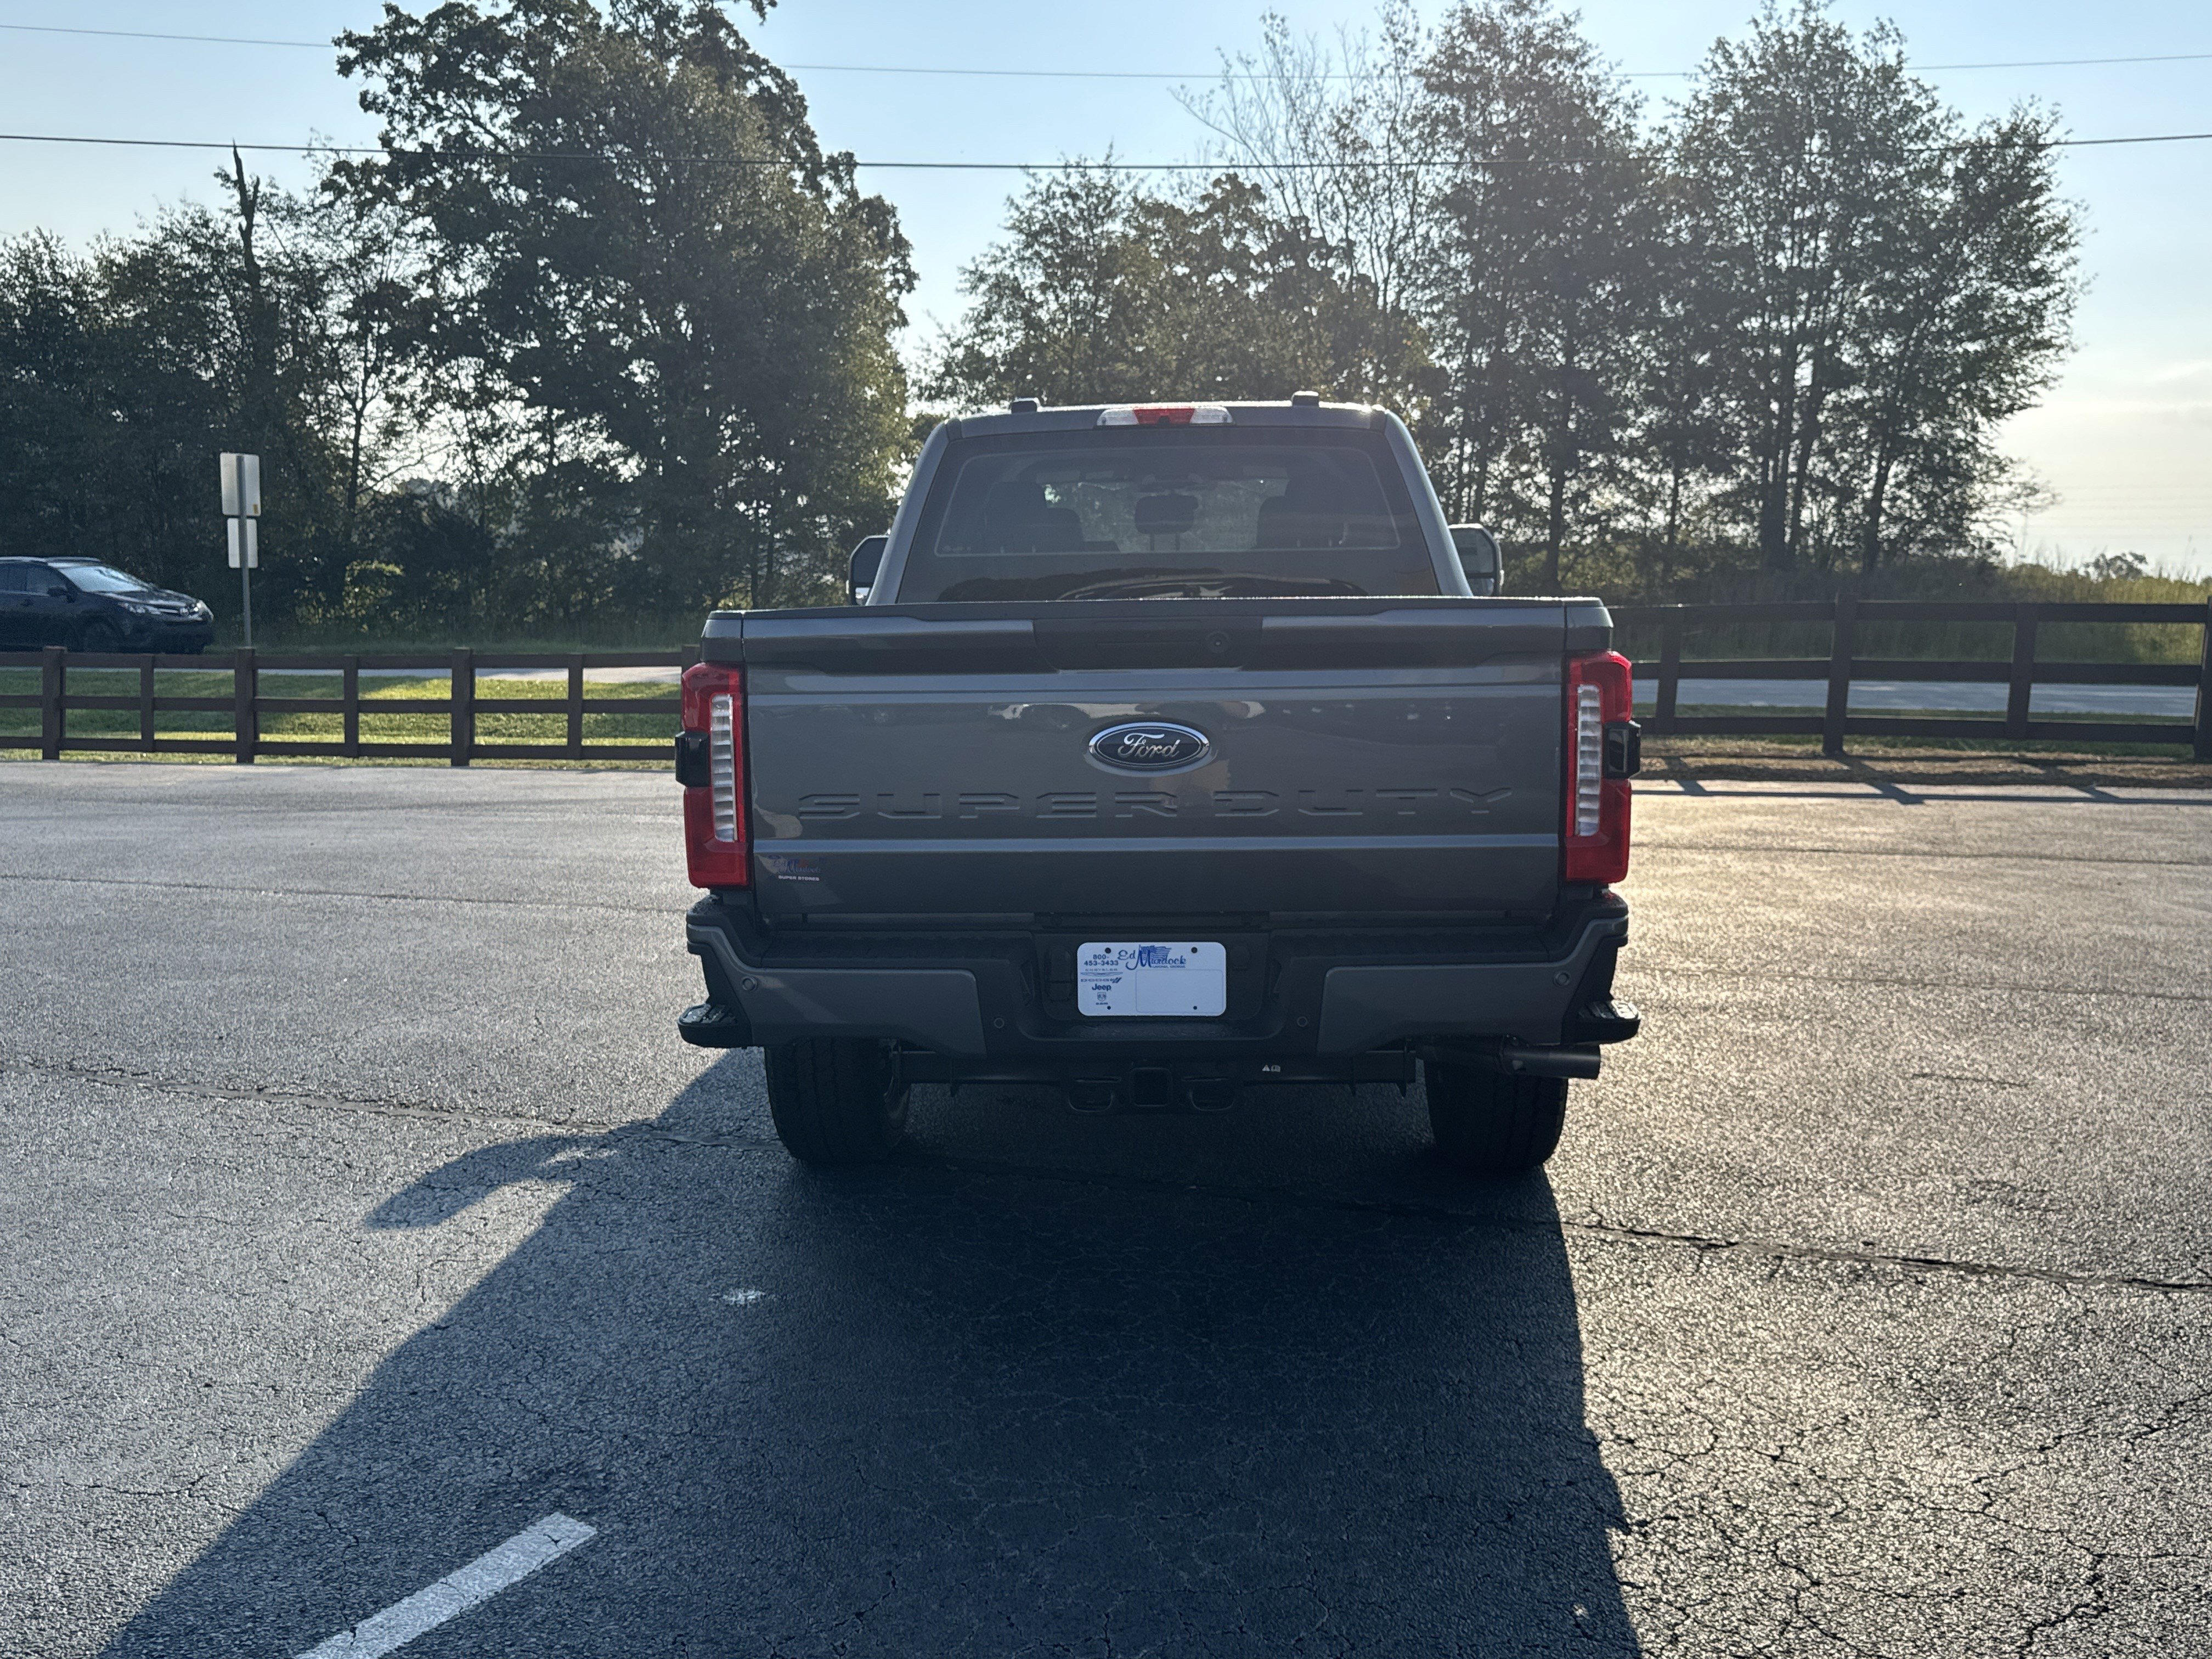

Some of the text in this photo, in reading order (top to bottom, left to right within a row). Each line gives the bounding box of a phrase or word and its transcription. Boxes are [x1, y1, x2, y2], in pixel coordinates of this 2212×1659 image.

[1118, 732, 1181, 758] Ford
[798, 788, 1513, 819] SUPER DUTY
[1117, 949, 1186, 970] Ed Murdock
[1092, 983, 1111, 991] Jeep
